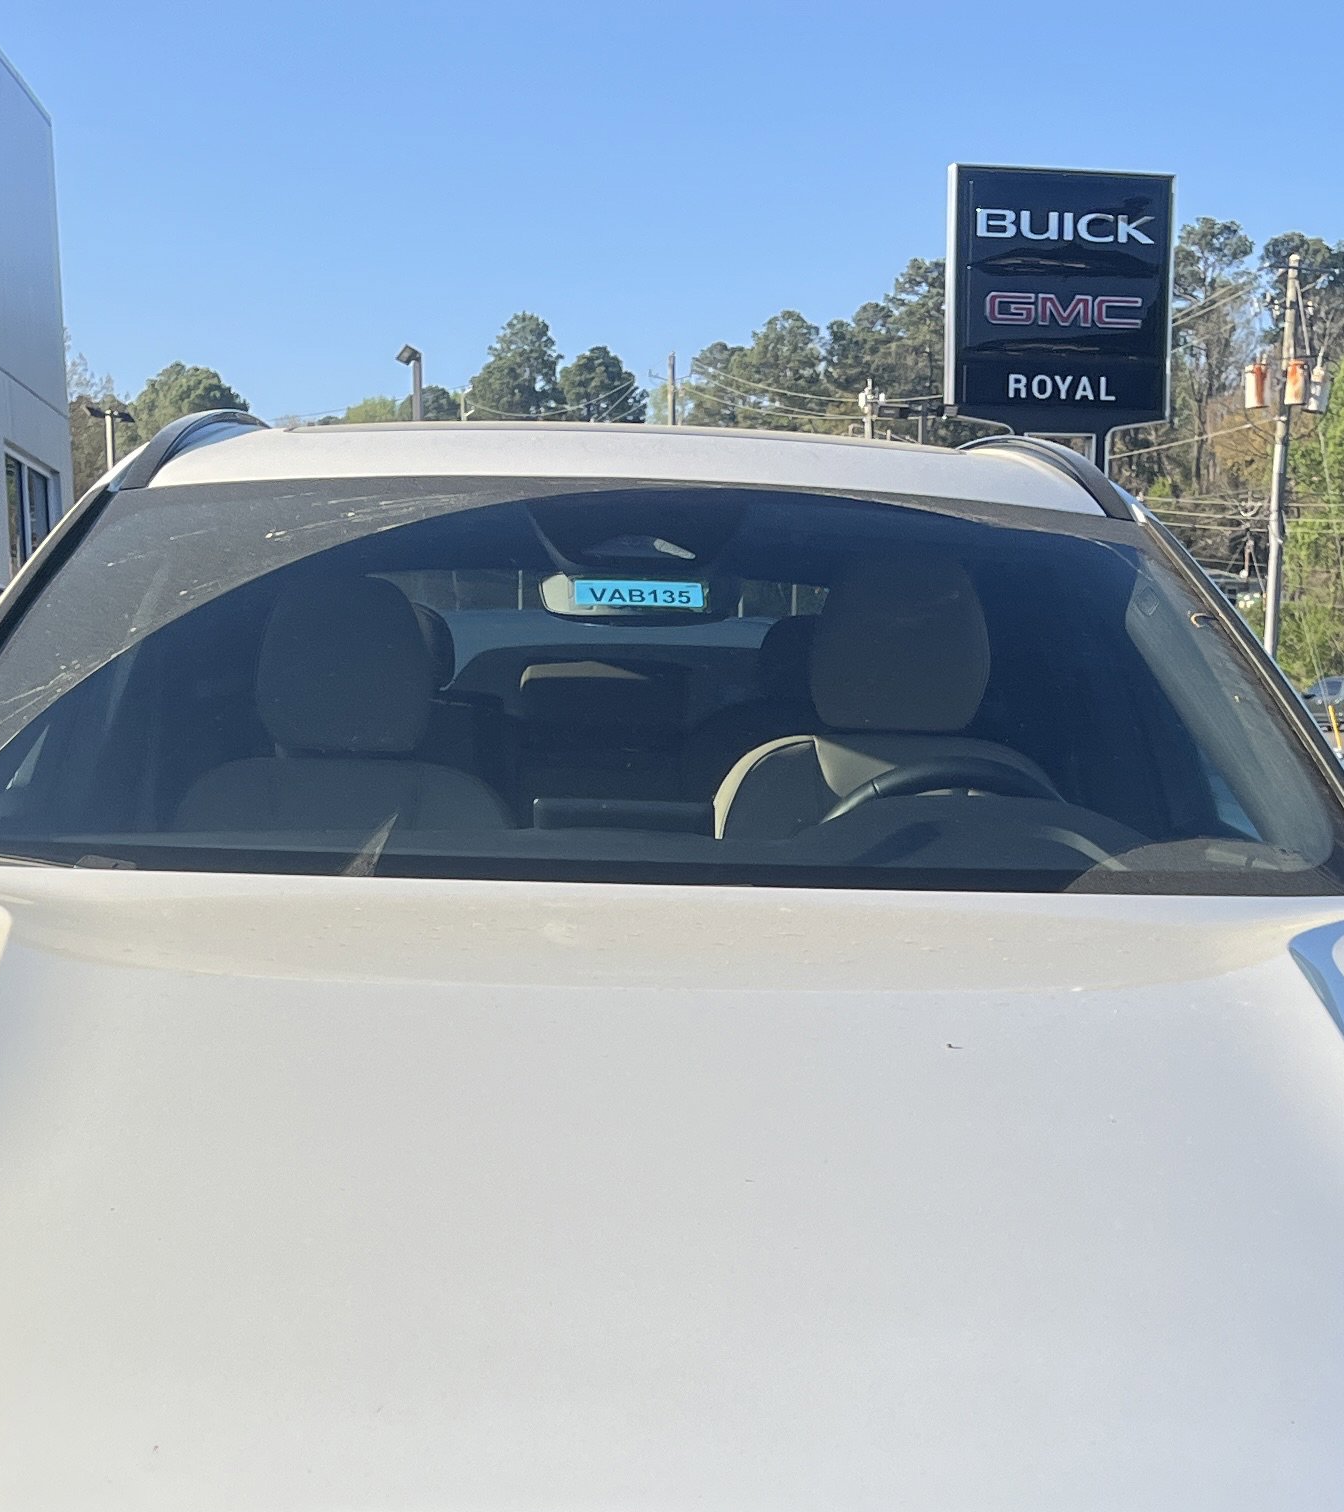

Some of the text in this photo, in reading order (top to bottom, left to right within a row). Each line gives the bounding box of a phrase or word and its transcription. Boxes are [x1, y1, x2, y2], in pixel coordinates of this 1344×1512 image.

[976, 208, 1155, 244] BUICK
[986, 291, 1142, 329] GMC
[1008, 374, 1116, 401] ROYAL
[589, 587, 691, 604] VAB135
